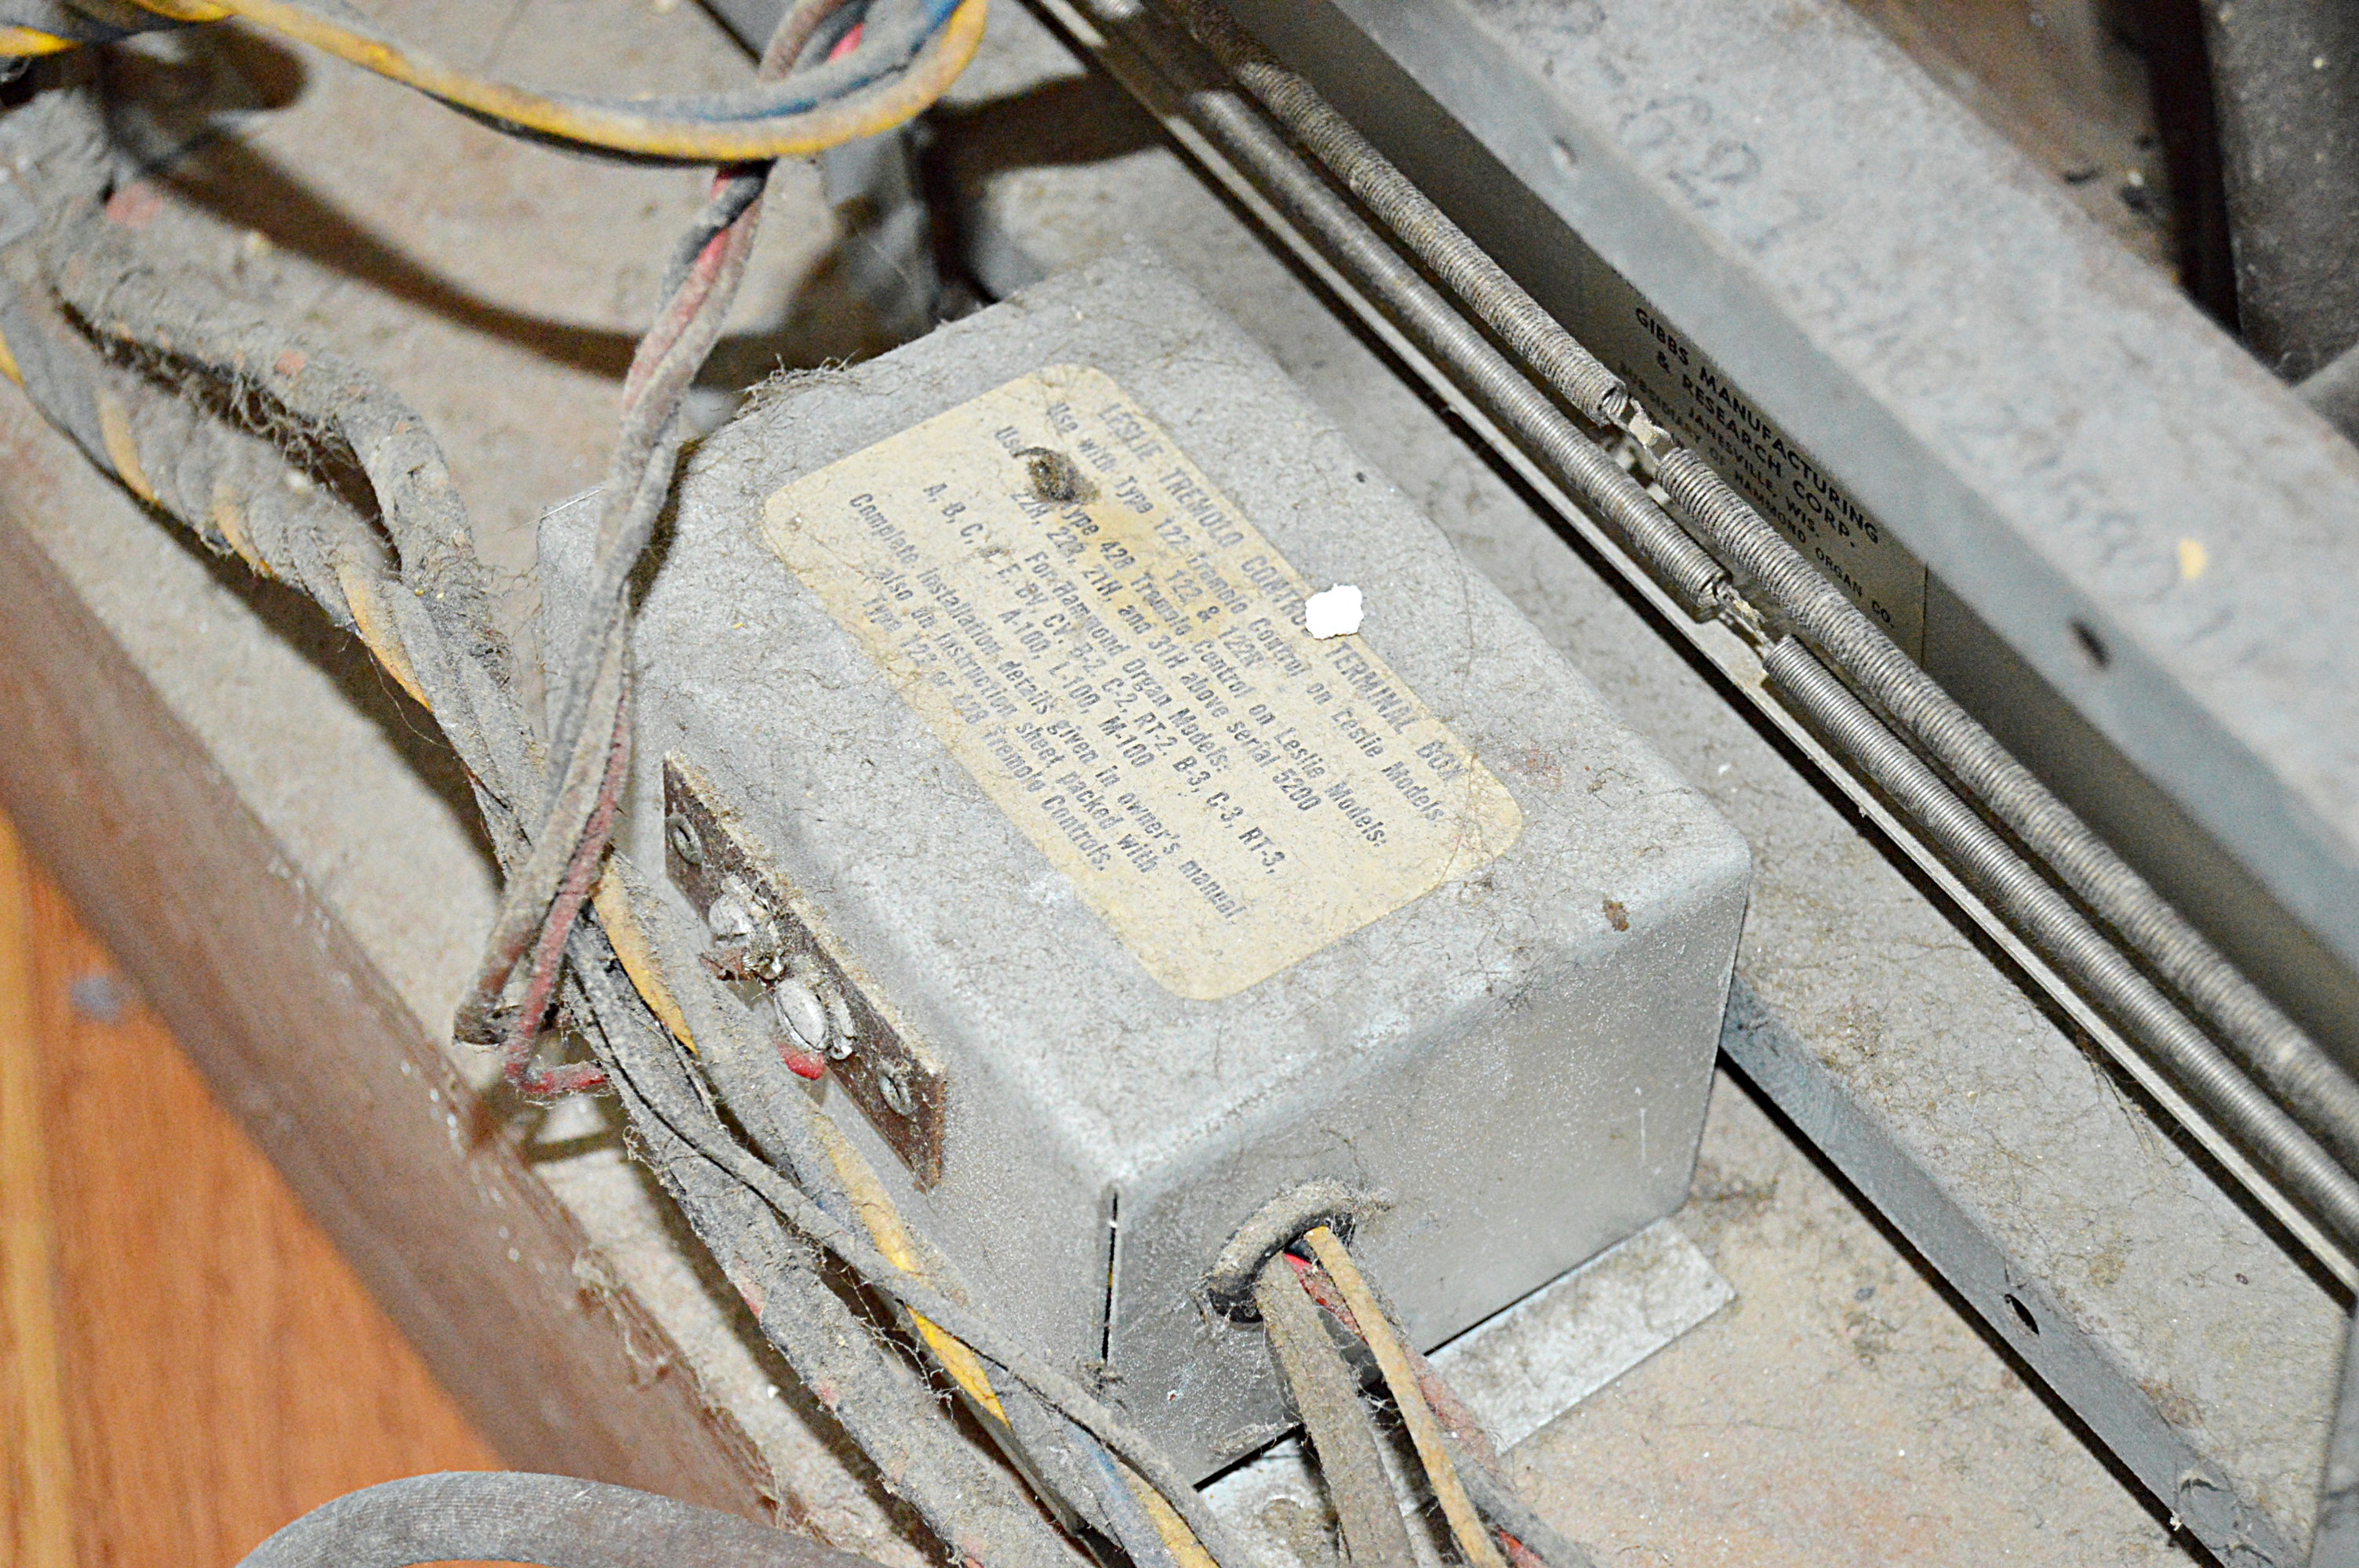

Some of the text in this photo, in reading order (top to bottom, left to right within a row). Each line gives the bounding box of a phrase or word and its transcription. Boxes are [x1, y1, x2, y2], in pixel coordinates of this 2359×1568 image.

[1635, 307, 1689, 366] GIBBS
[1699, 366, 1878, 544] MANUFACTURING
[1656, 350, 1670, 374] &
[1682, 374, 1781, 477] RESEARCH
[1792, 479, 1856, 548] CORP.
[1785, 496, 1819, 538] WIS.
[1023, 550, 1230, 773] For Hammond Organ Models:
[1045, 401, 1079, 433] Use
[1078, 437, 1117, 466] with
[1115, 474, 1154, 514] Type
[1153, 517, 1191, 548] 122
[1185, 552, 1249, 615] Tremolo
[1248, 617, 1313, 677] Control
[1306, 682, 1333, 706] on
[1330, 706, 1384, 758] Leslie
[1096, 403, 1470, 782] LESLIE TREMOLO CONTRO TERMINAL BOX
[1165, 569, 1203, 604] 122
[1196, 605, 1220, 622] &
[1735, 470, 1806, 543] HAMMOND
[1816, 547, 1863, 597] ORGAN
[1872, 600, 1895, 629] CO.
[849, 492, 920, 564] Complete
[916, 567, 1004, 653] installation
[997, 660, 1056, 715] details
[1046, 720, 1100, 765] given
[1095, 764, 1121, 787] in
[1117, 792, 1182, 855] owner's
[862, 594, 902, 632] Type
[929, 670, 956, 688] or
[982, 725, 1046, 793] Tremolo
[1041, 794, 1112, 872] Controls.
[873, 567, 914, 601] also
[933, 632, 1018, 715] instruction
[1014, 722, 1066, 768] sheet
[1055, 771, 1124, 830] packed
[1116, 833, 1159, 873] with
[922, 481, 948, 503] A,
[940, 501, 967, 524] B,
[959, 522, 990, 545] C,
[1101, 677, 1138, 713] C-2,
[1172, 755, 1212, 793] B-3,
[1205, 790, 1245, 829] C-3,
[1238, 826, 1286, 875] RT-3,
[998, 608, 1155, 768] A-100, L-100, M-100
[1081, 564, 1124, 603] 21H,
[1117, 604, 1152, 635] and
[1147, 634, 1190, 670] 31H
[1180, 672, 1230, 718] above
[1226, 720, 1281, 768] serial
[1271, 768, 1322, 811] 5200
[1100, 540, 1136, 569] 428
[1130, 571, 1193, 637] Tremolo
[1191, 640, 1256, 699] Control
[1249, 703, 1277, 727] on
[1273, 726, 1325, 779] Leslie
[1324, 780, 1388, 848] Models:
